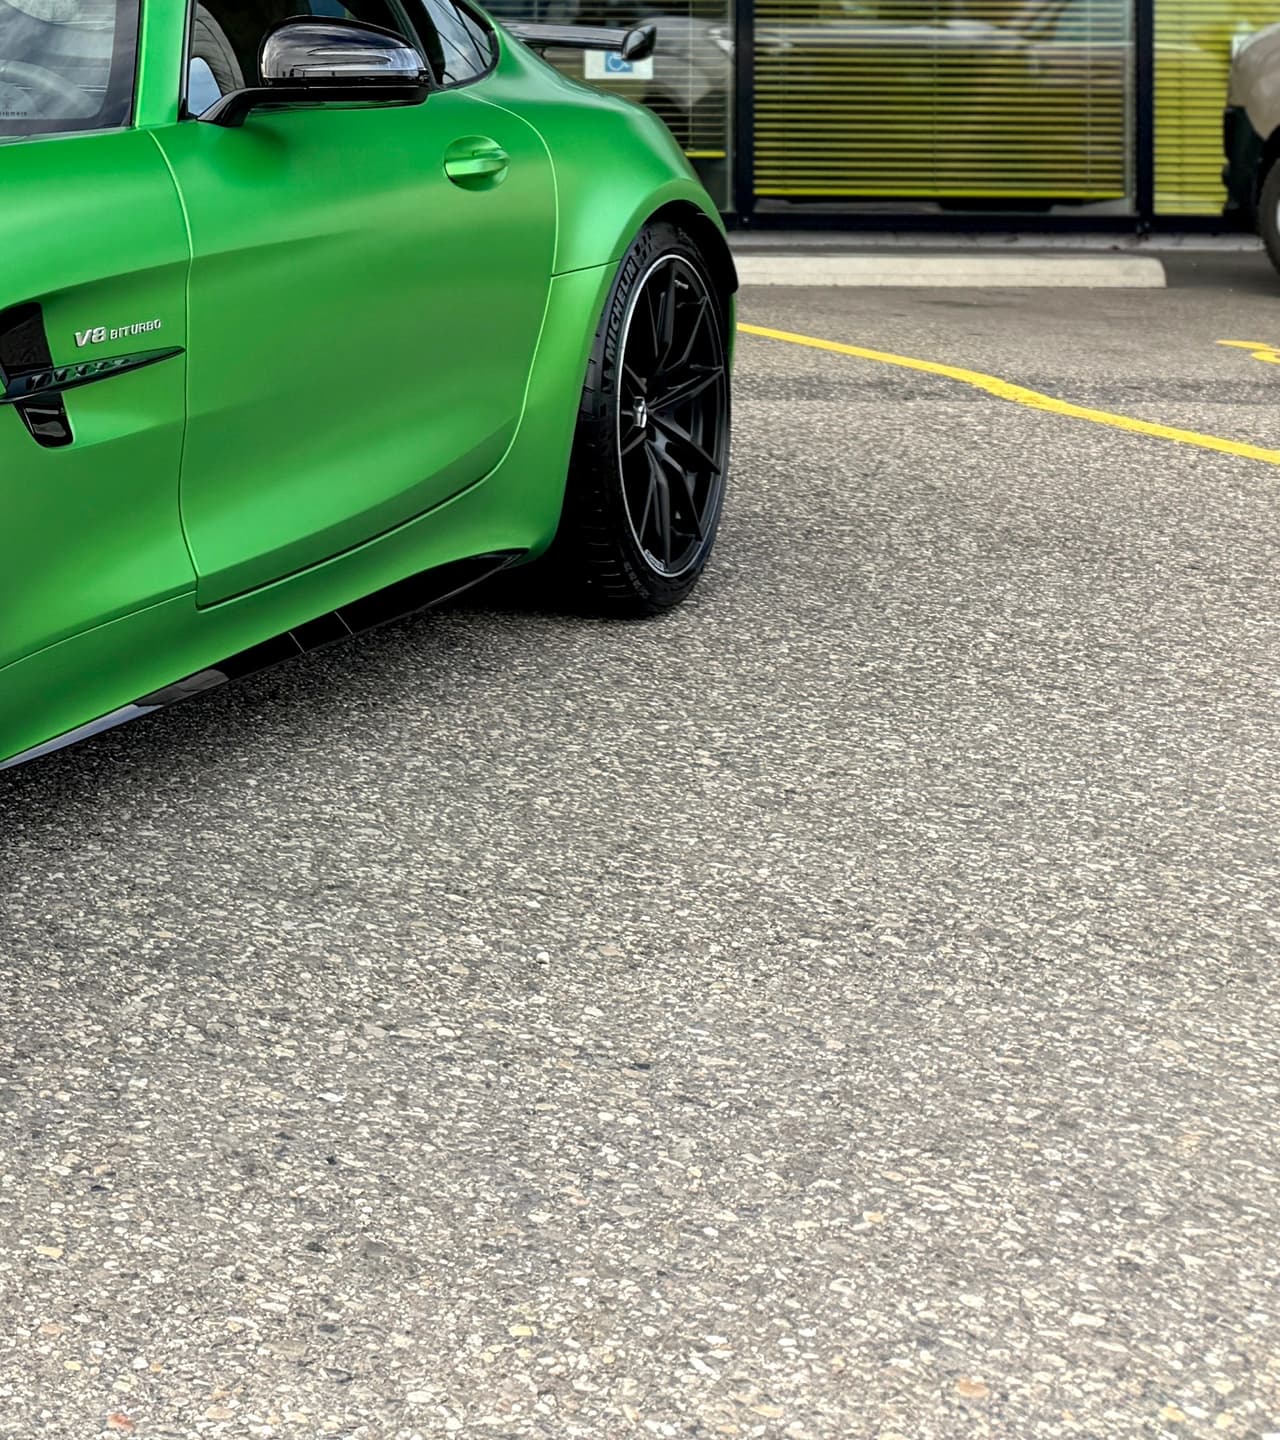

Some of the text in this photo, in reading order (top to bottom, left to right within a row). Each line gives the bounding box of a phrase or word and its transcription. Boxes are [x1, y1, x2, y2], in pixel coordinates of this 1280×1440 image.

[74, 319, 162, 348] V8 BITURBO
[605, 258, 638, 364] MICHELIN
